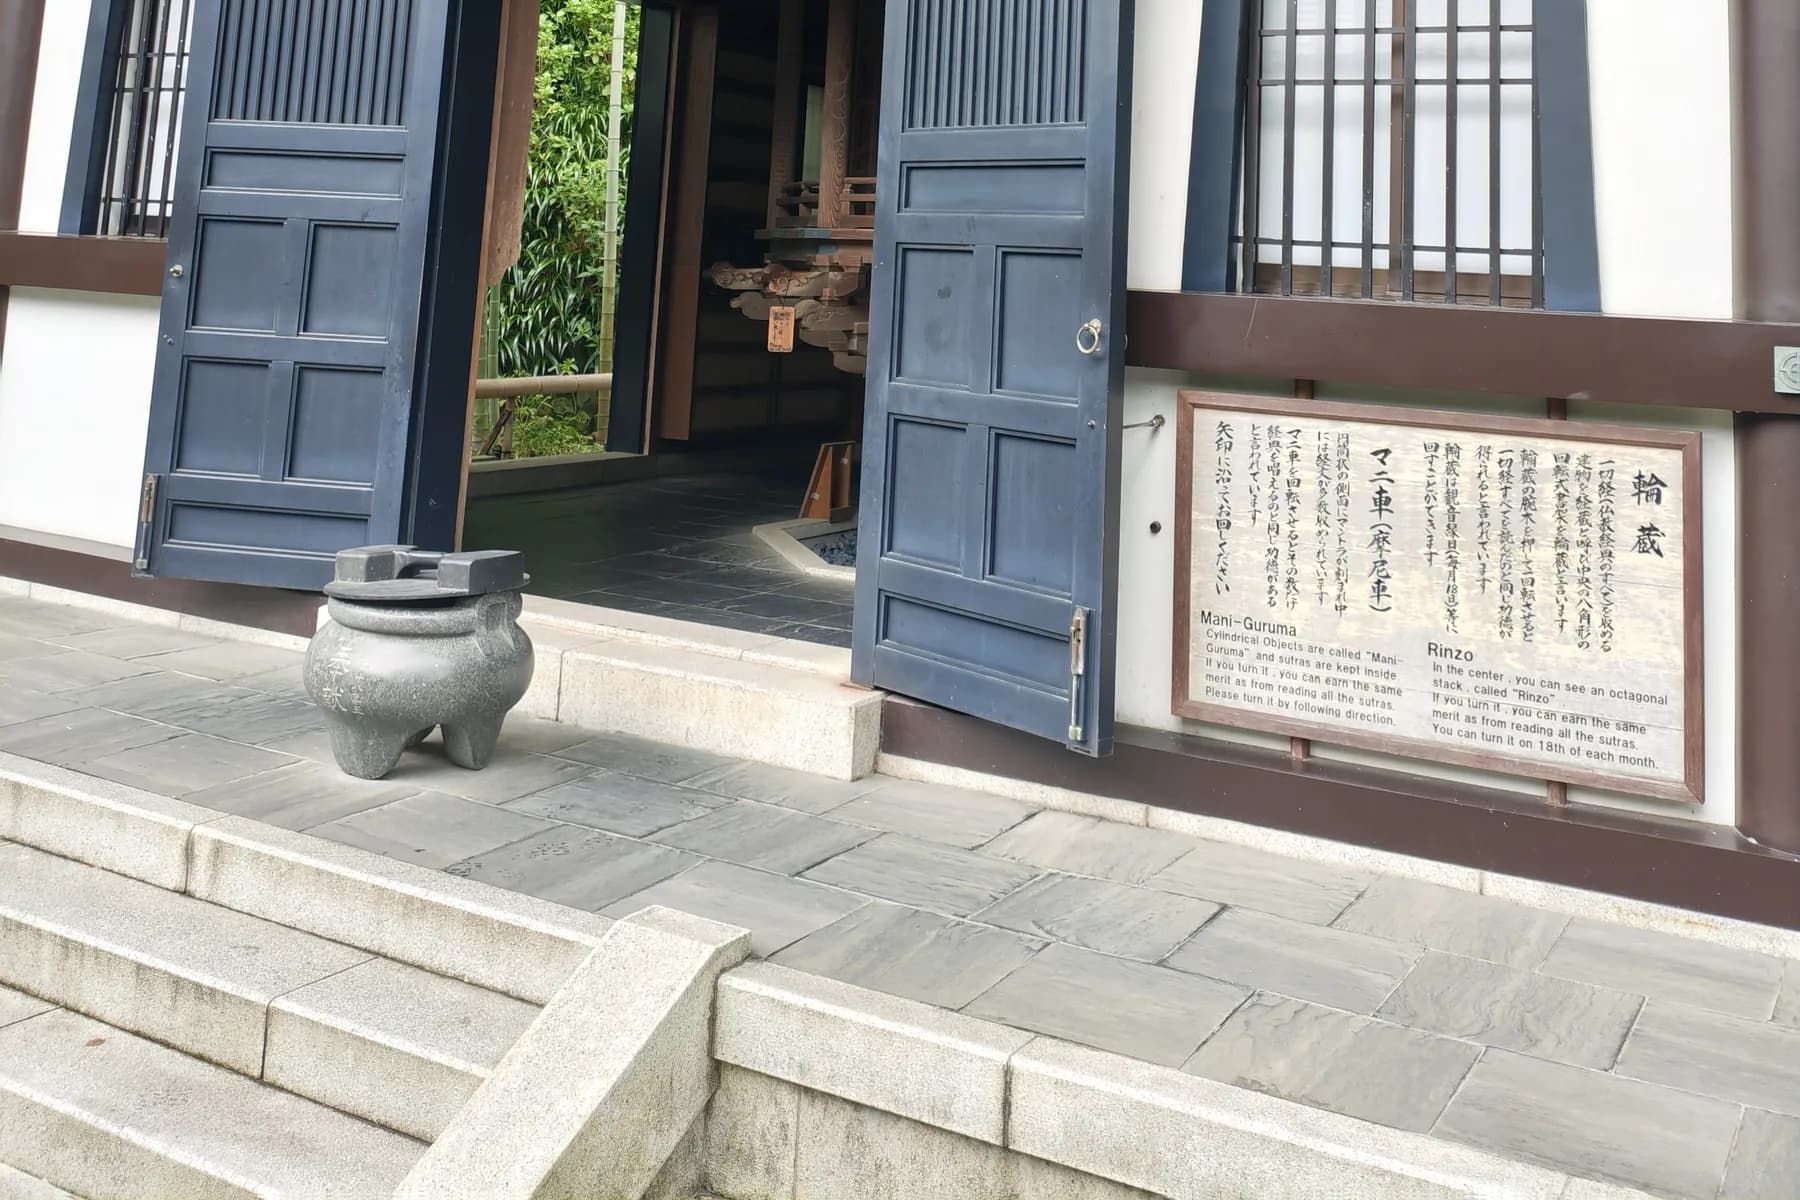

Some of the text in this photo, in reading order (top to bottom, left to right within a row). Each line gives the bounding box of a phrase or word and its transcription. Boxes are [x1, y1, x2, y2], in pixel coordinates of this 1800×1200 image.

[1200, 610, 1297, 637] Mani-Guruma
[1206, 628, 1259, 645] Cylindrical
[1263, 637, 1303, 651] Objects
[1308, 645, 1325, 654] are
[1328, 648, 1361, 660] called
[1427, 642, 1474, 662] Rinzo
[1205, 657, 1212, 667] If
[1216, 660, 1234, 671] you
[1238, 662, 1258, 674] turn
[1261, 666, 1269, 676] it
[1279, 670, 1298, 680] you
[1302, 673, 1321, 684] can
[1325, 676, 1349, 688] earn
[1352, 679, 1370, 692] the
[1374, 684, 1403, 697] same
[1256, 652, 1275, 662] and
[1279, 655, 1311, 667] sutras
[1315, 661, 1332, 671] are
[1336, 662, 1360, 675] kept
[1205, 672, 1231, 685] merit
[1235, 678, 1246, 687] as
[1250, 678, 1274, 692] from
[1277, 684, 1317, 699] reading
[1321, 690, 1333, 700] all
[1337, 692, 1354, 704] the
[1432, 661, 1442, 672] In
[1446, 663, 1464, 675] the
[1468, 668, 1504, 681] center
[1515, 675, 1535, 686] you
[1540, 679, 1560, 690] can
[1565, 683, 1586, 693] see
[1590, 687, 1605, 696] an
[1609, 689, 1668, 705] octagonal
[1433, 678, 1463, 692] stack
[1473, 684, 1507, 698] called
[1205, 685, 1239, 700] Please
[1243, 692, 1263, 705] turn
[1266, 696, 1274, 706] it
[1277, 698, 1290, 709] by
[1294, 700, 1341, 717] following
[1432, 692, 1439, 703] If
[1444, 695, 1463, 706] you
[1467, 697, 1489, 710] turn
[1493, 702, 1501, 712] it
[1511, 706, 1532, 717] you
[1536, 710, 1557, 721] can
[1561, 713, 1587, 726] earn
[1591, 716, 1610, 729] the
[1615, 721, 1647, 735] same
[1432, 709, 1460, 721] merit
[1464, 714, 1477, 724] as
[1481, 715, 1507, 729] from
[1510, 720, 1553, 737] reading
[1558, 727, 1571, 739] all
[1575, 729, 1594, 743] the
[1432, 722, 1453, 736] You
[1457, 728, 1477, 740] can
[1481, 731, 1503, 744] turn
[1507, 734, 1514, 746] it
[1518, 739, 1533, 749] on
[1539, 740, 1565, 754] 18th
[1569, 745, 1581, 757] of
[1585, 749, 1615, 762] each
